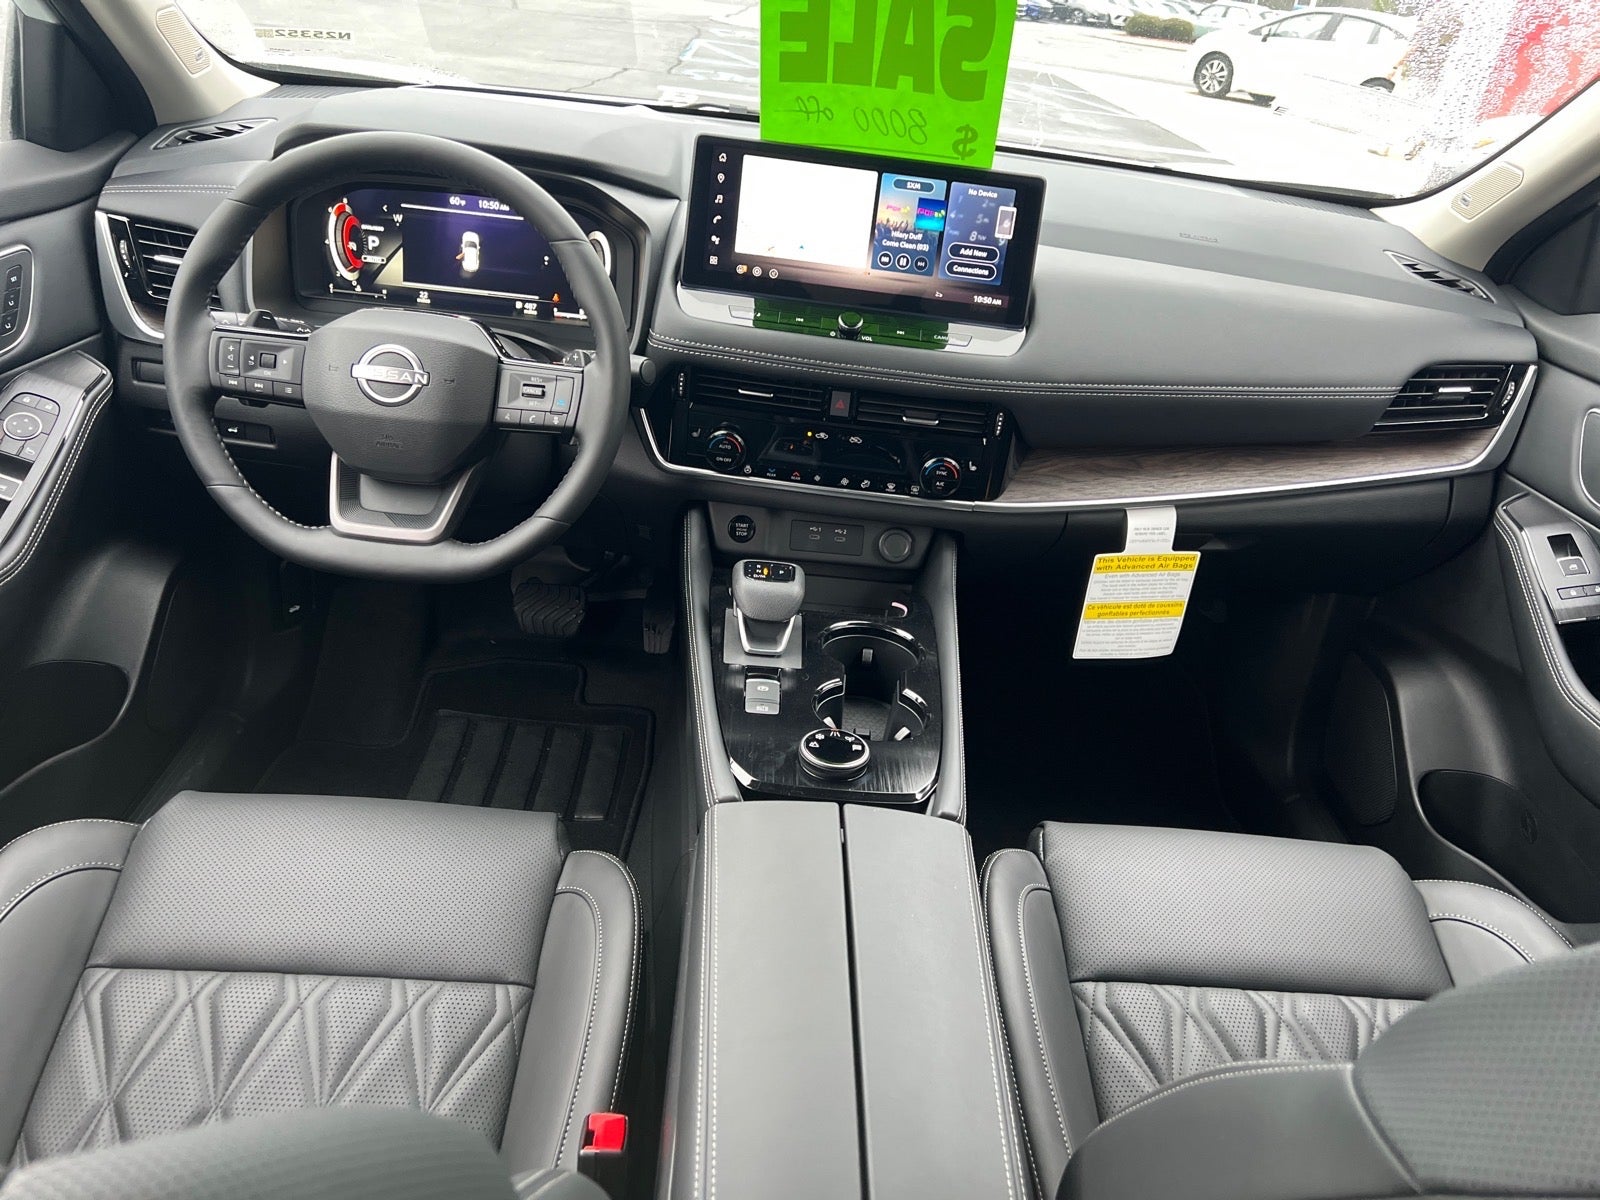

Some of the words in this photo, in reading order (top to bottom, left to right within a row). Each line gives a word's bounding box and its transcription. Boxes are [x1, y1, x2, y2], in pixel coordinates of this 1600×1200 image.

[978, 190, 998, 199] Device
[478, 199, 499, 211] 10:50
[969, 231, 978, 242] 8
[367, 235, 380, 250] P
[959, 247, 973, 256] Add
[953, 264, 989, 276] Connections
[973, 295, 992, 305] 10:50
[353, 368, 428, 385] SSAN
[1157, 555, 1196, 563] Equipped
[1172, 562, 1193, 570] Bags
